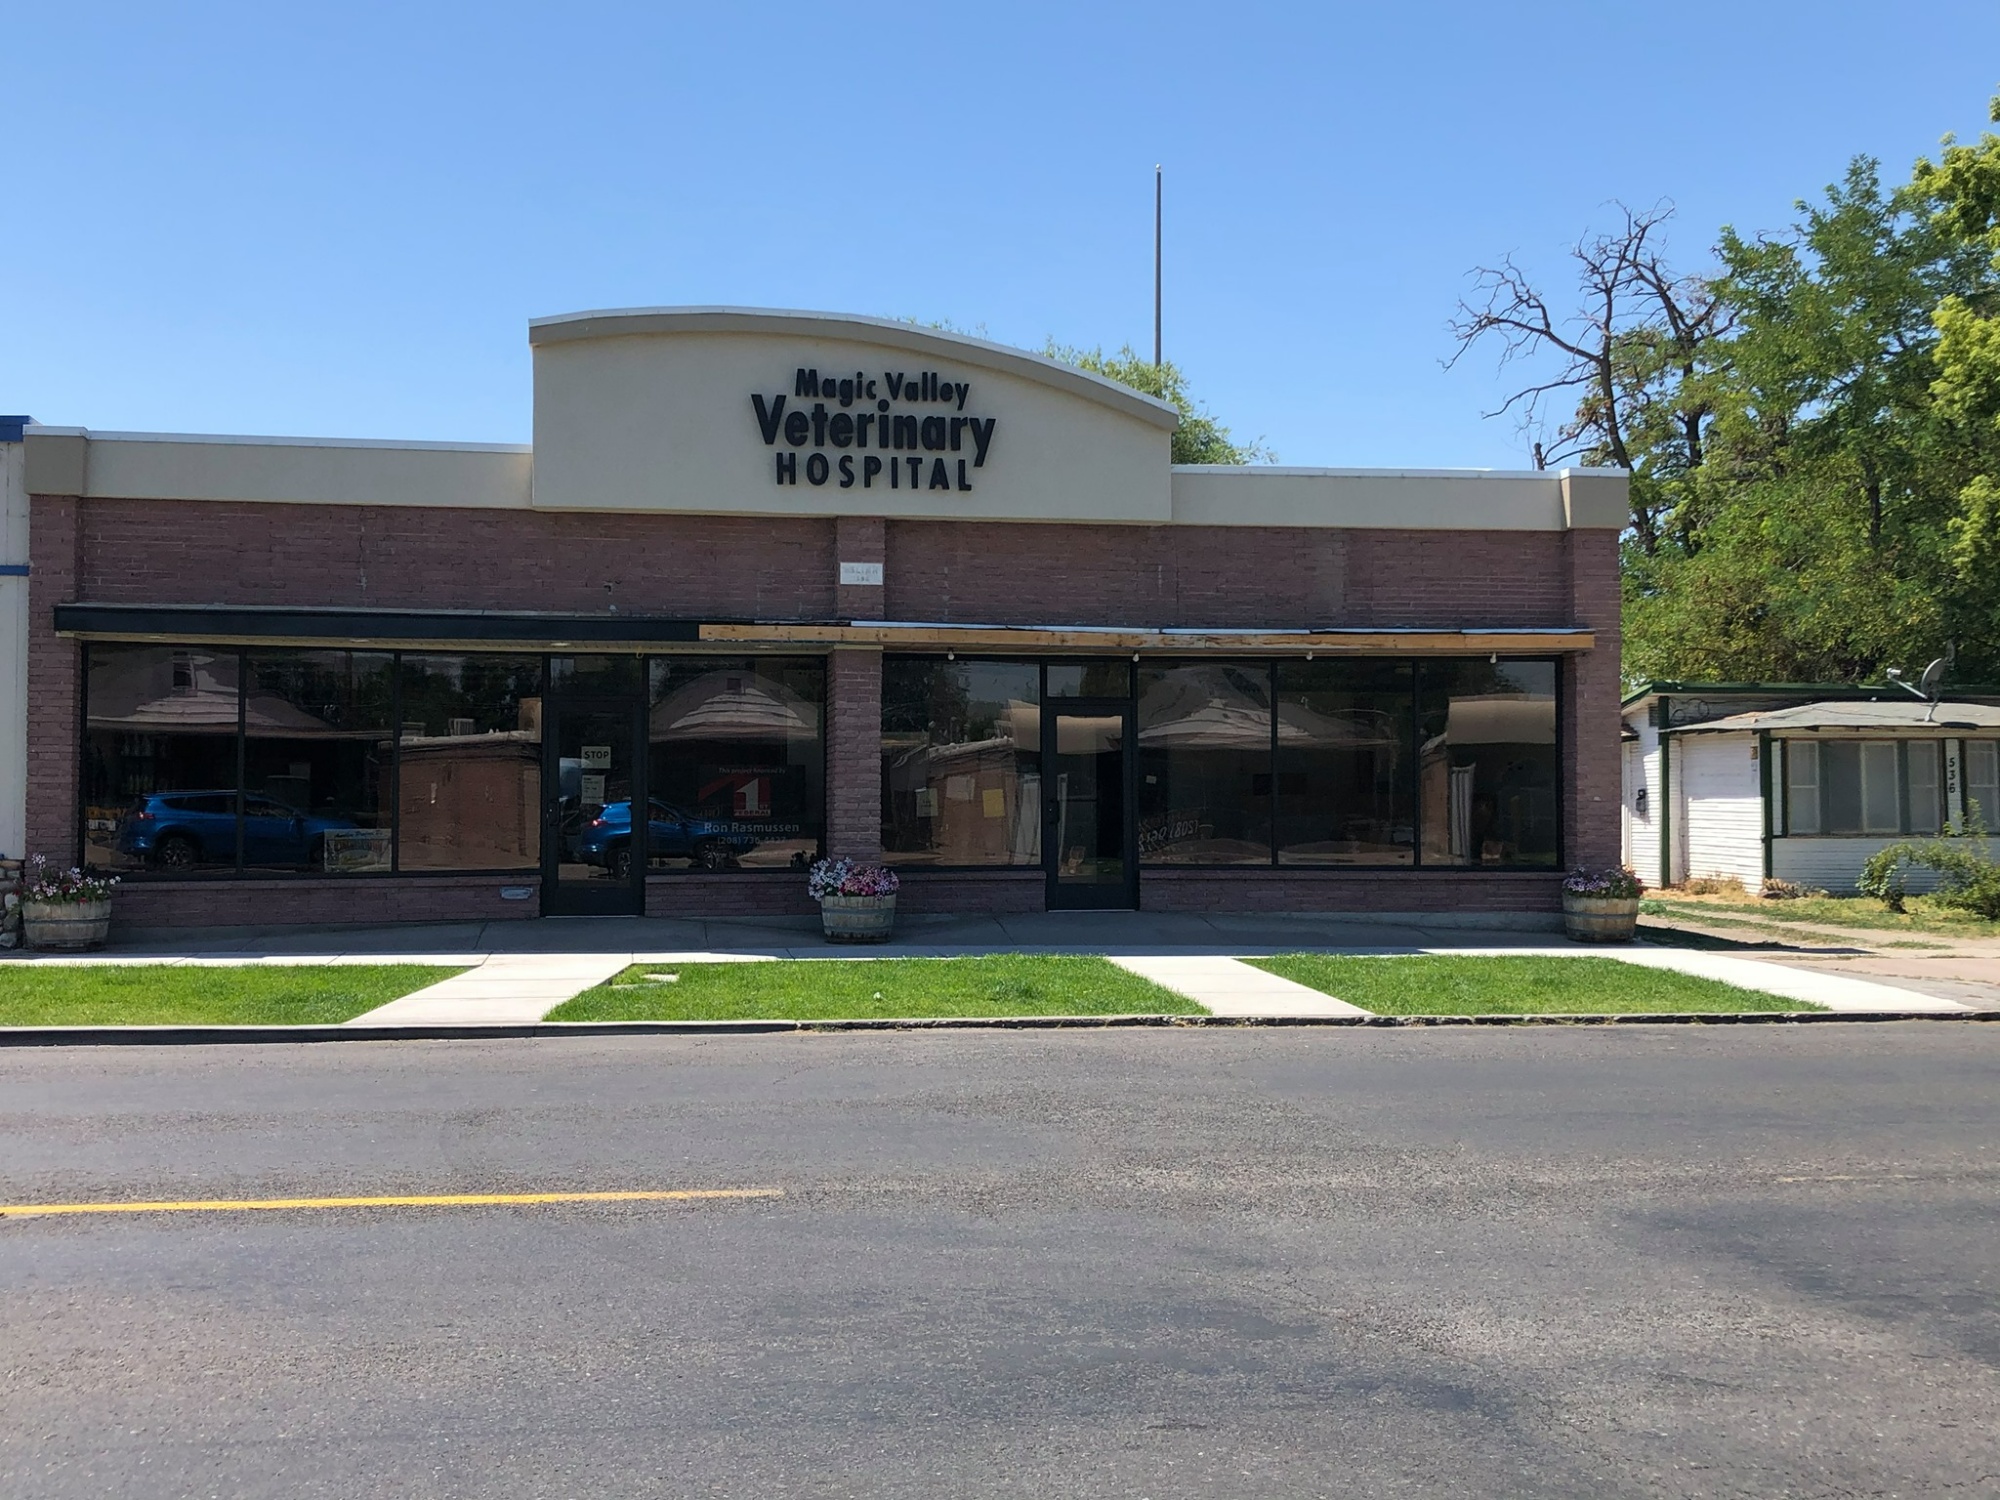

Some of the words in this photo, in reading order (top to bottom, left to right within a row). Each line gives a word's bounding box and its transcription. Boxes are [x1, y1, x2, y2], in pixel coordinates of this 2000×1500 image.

[795, 368, 877, 407] Magic
[884, 372, 970, 411] Valley
[751, 394, 997, 467] Veterinary
[776, 452, 972, 491] HOSPITAL
[584, 750, 609, 759] STOP
[704, 822, 728, 833] Ron
[731, 822, 800, 833] Rasmussen
[717, 836, 741, 845] (208)
